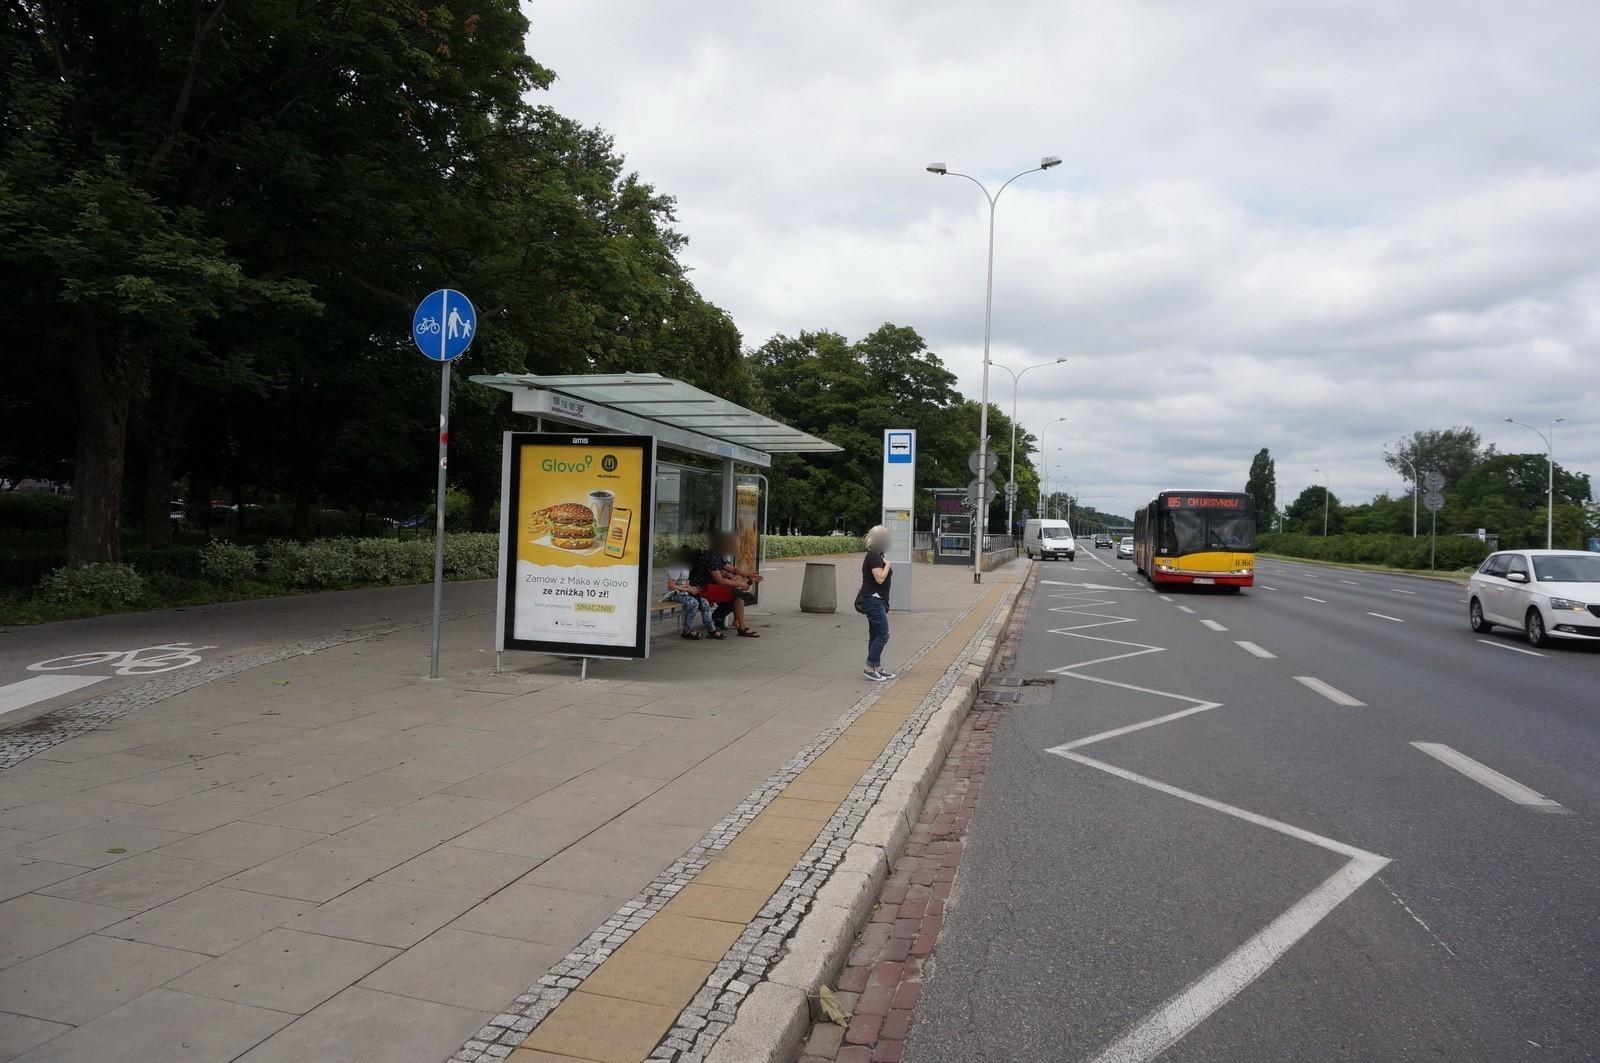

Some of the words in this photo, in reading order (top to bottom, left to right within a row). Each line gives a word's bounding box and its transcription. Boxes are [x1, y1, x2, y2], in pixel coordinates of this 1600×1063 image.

[542, 459, 586, 472] Glovo
[1168, 497, 1180, 507] 185
[526, 574, 557, 584] Zamów
[560, 577, 565, 585] z
[567, 576, 591, 586] Maka
[593, 578, 601, 586] w
[602, 579, 628, 588] Glovo
[555, 587, 584, 598] zniżką
[586, 589, 596, 597] 10
[598, 590, 609, 598] zł!
